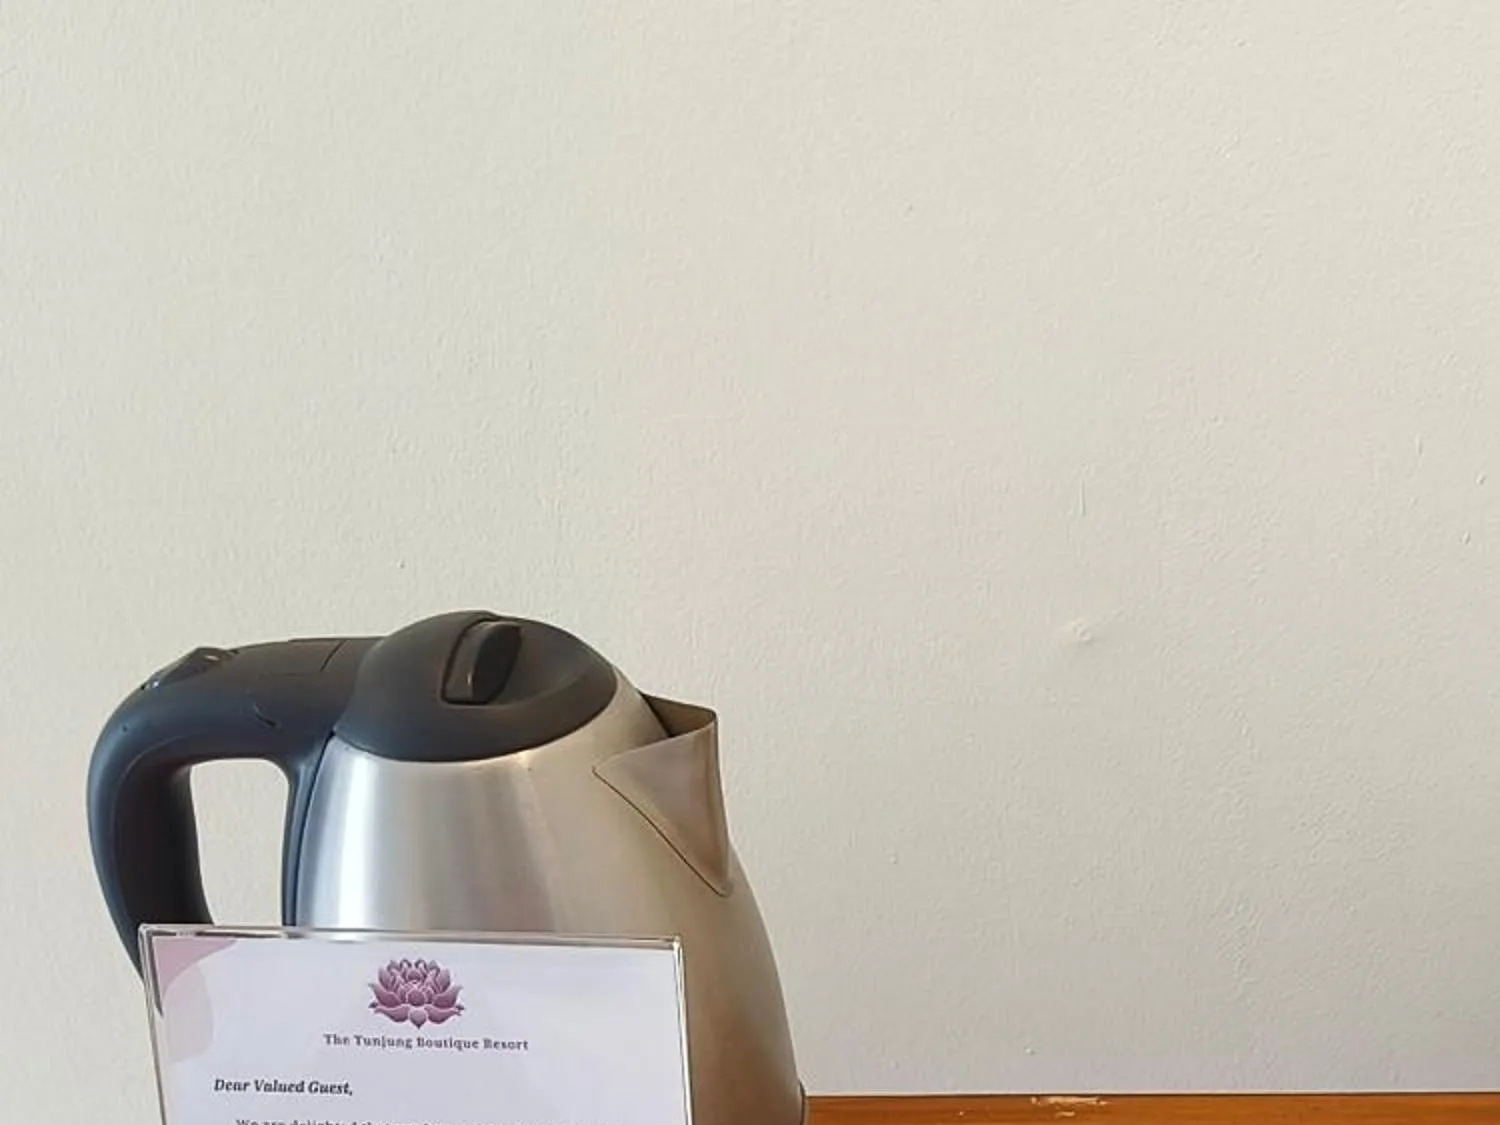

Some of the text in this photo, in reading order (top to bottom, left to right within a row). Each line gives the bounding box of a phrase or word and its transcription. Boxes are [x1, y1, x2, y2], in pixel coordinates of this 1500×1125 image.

[324, 1033, 350, 1046] The
[354, 1034, 412, 1050] Tunjung
[416, 1035, 479, 1051] Boutique
[214, 1079, 353, 1096] Dear Valued Guest,
